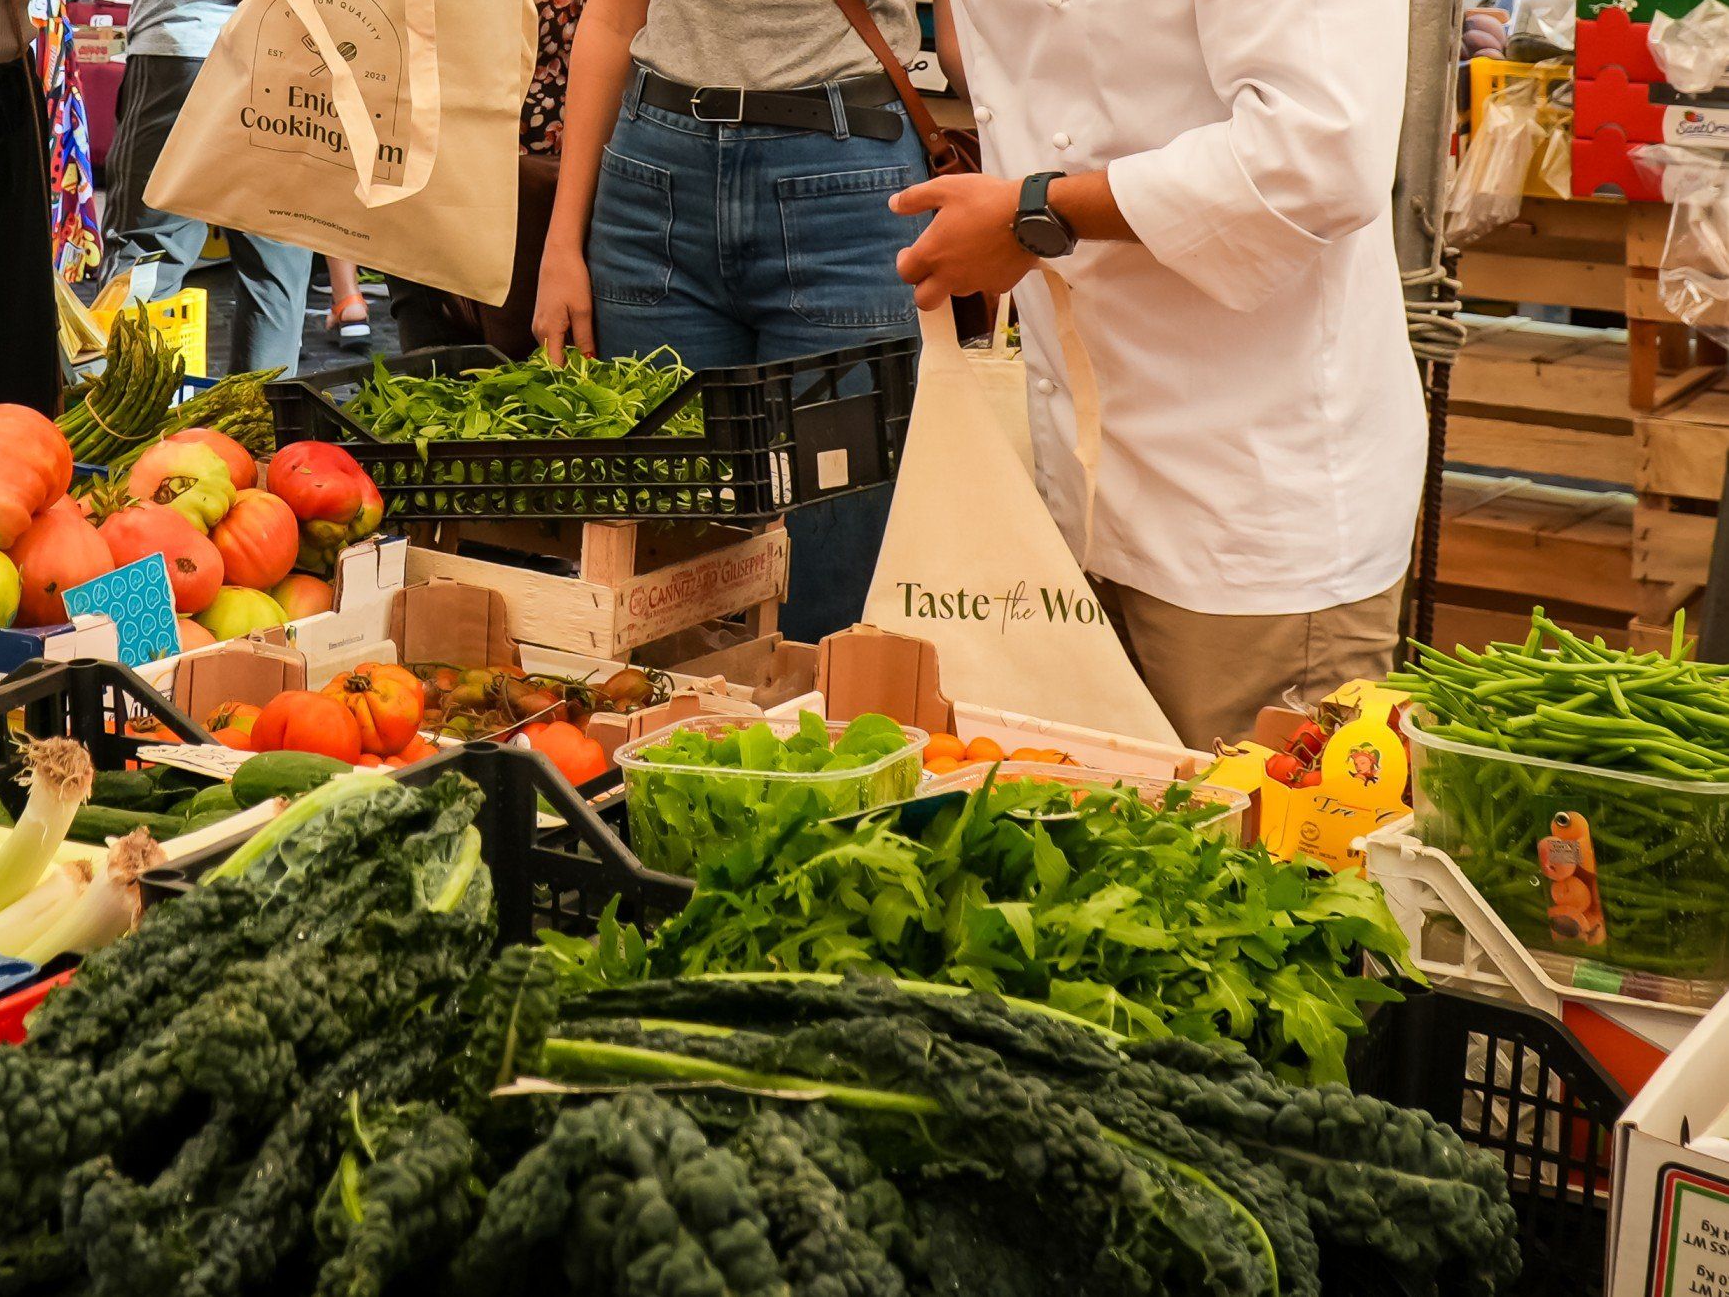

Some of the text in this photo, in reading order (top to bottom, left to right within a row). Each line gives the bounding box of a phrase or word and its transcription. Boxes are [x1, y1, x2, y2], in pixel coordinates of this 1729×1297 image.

[340, 1, 382, 41] QUALITY
[268, 47, 286, 59] EST.
[364, 70, 387, 82] 2023
[288, 85, 340, 118] Enjo
[240, 106, 404, 165] Cooking.m
[268, 208, 370, 241] www.enjoycooking.com
[648, 568, 718, 609] CANNIZZARO
[721, 553, 766, 584] GIUSEPPE
[896, 582, 990, 621] Taste
[993, 580, 1036, 635] the
[1683, 1232, 1707, 1250] WT
[1697, 1264, 1715, 1283] Kg
